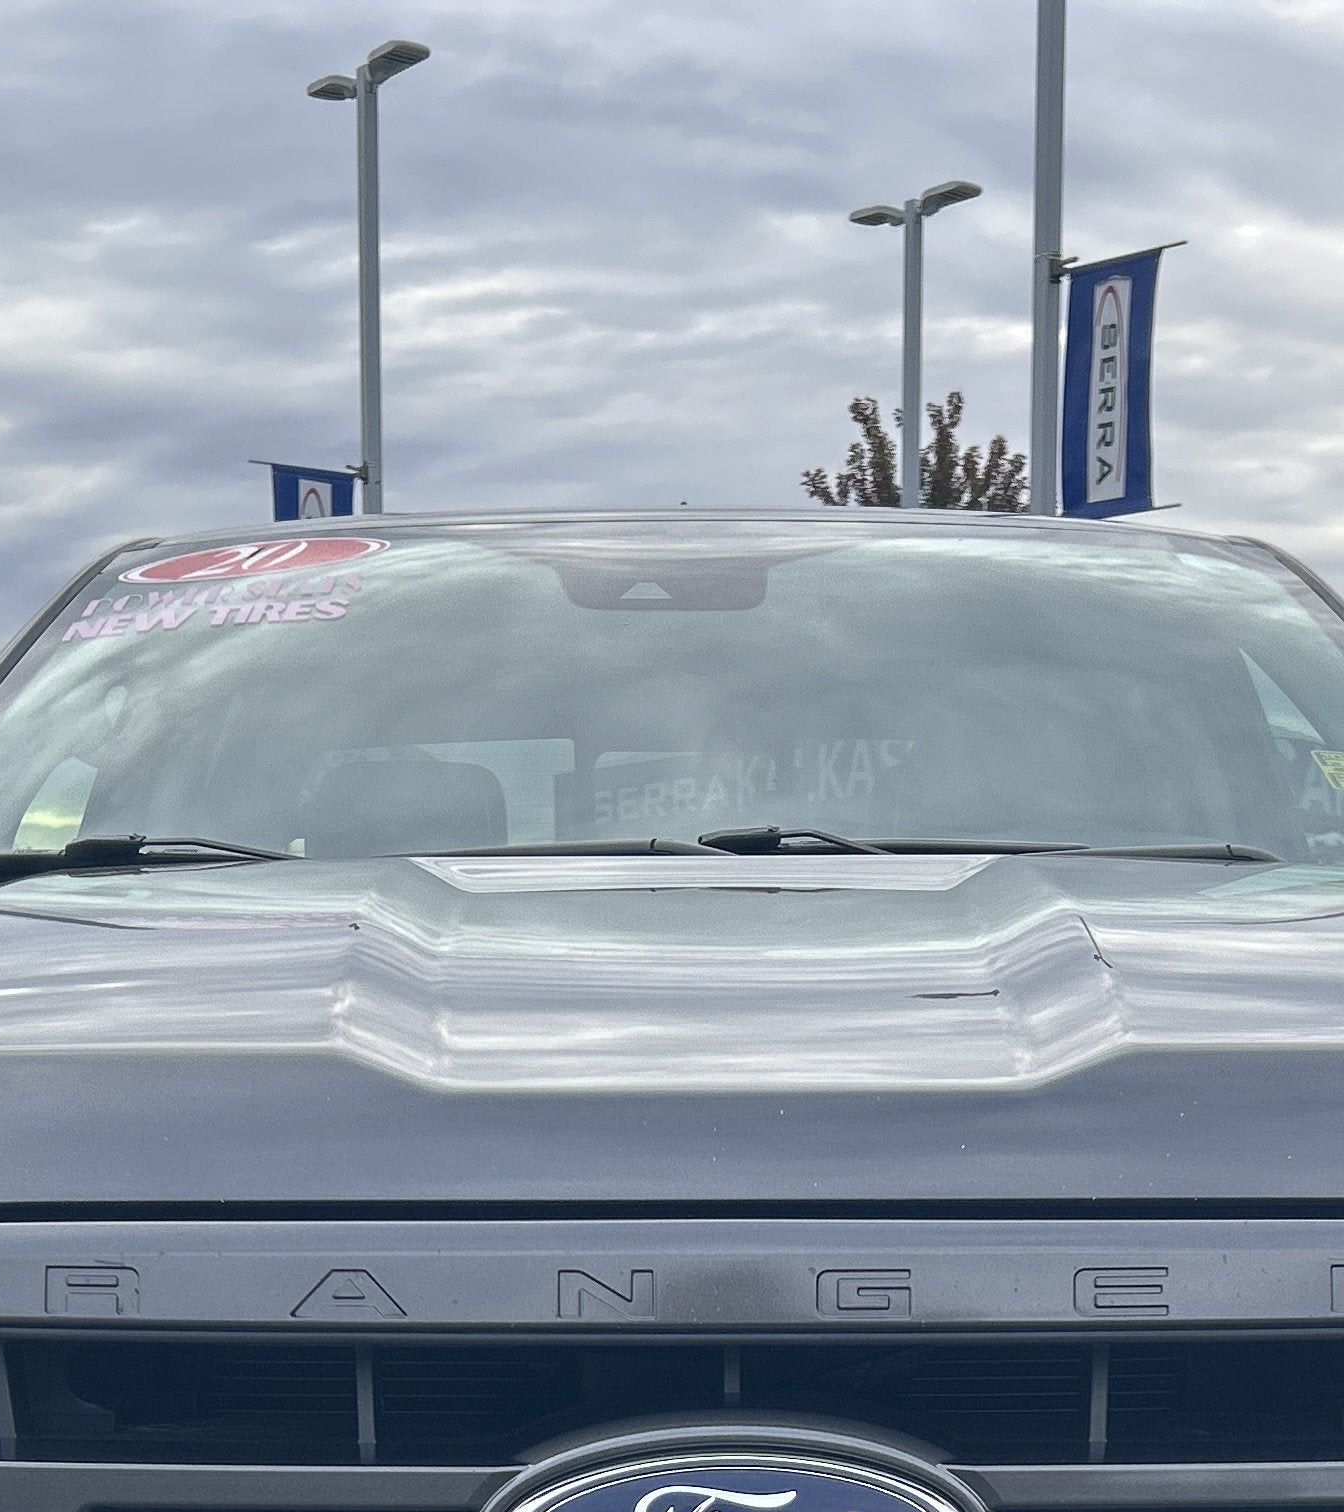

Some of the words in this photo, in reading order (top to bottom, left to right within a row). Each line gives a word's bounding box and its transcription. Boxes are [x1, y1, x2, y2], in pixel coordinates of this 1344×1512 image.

[1095, 323, 1118, 486] SERRA
[61, 608, 199, 643] NEW
[209, 600, 350, 626] TIRES
